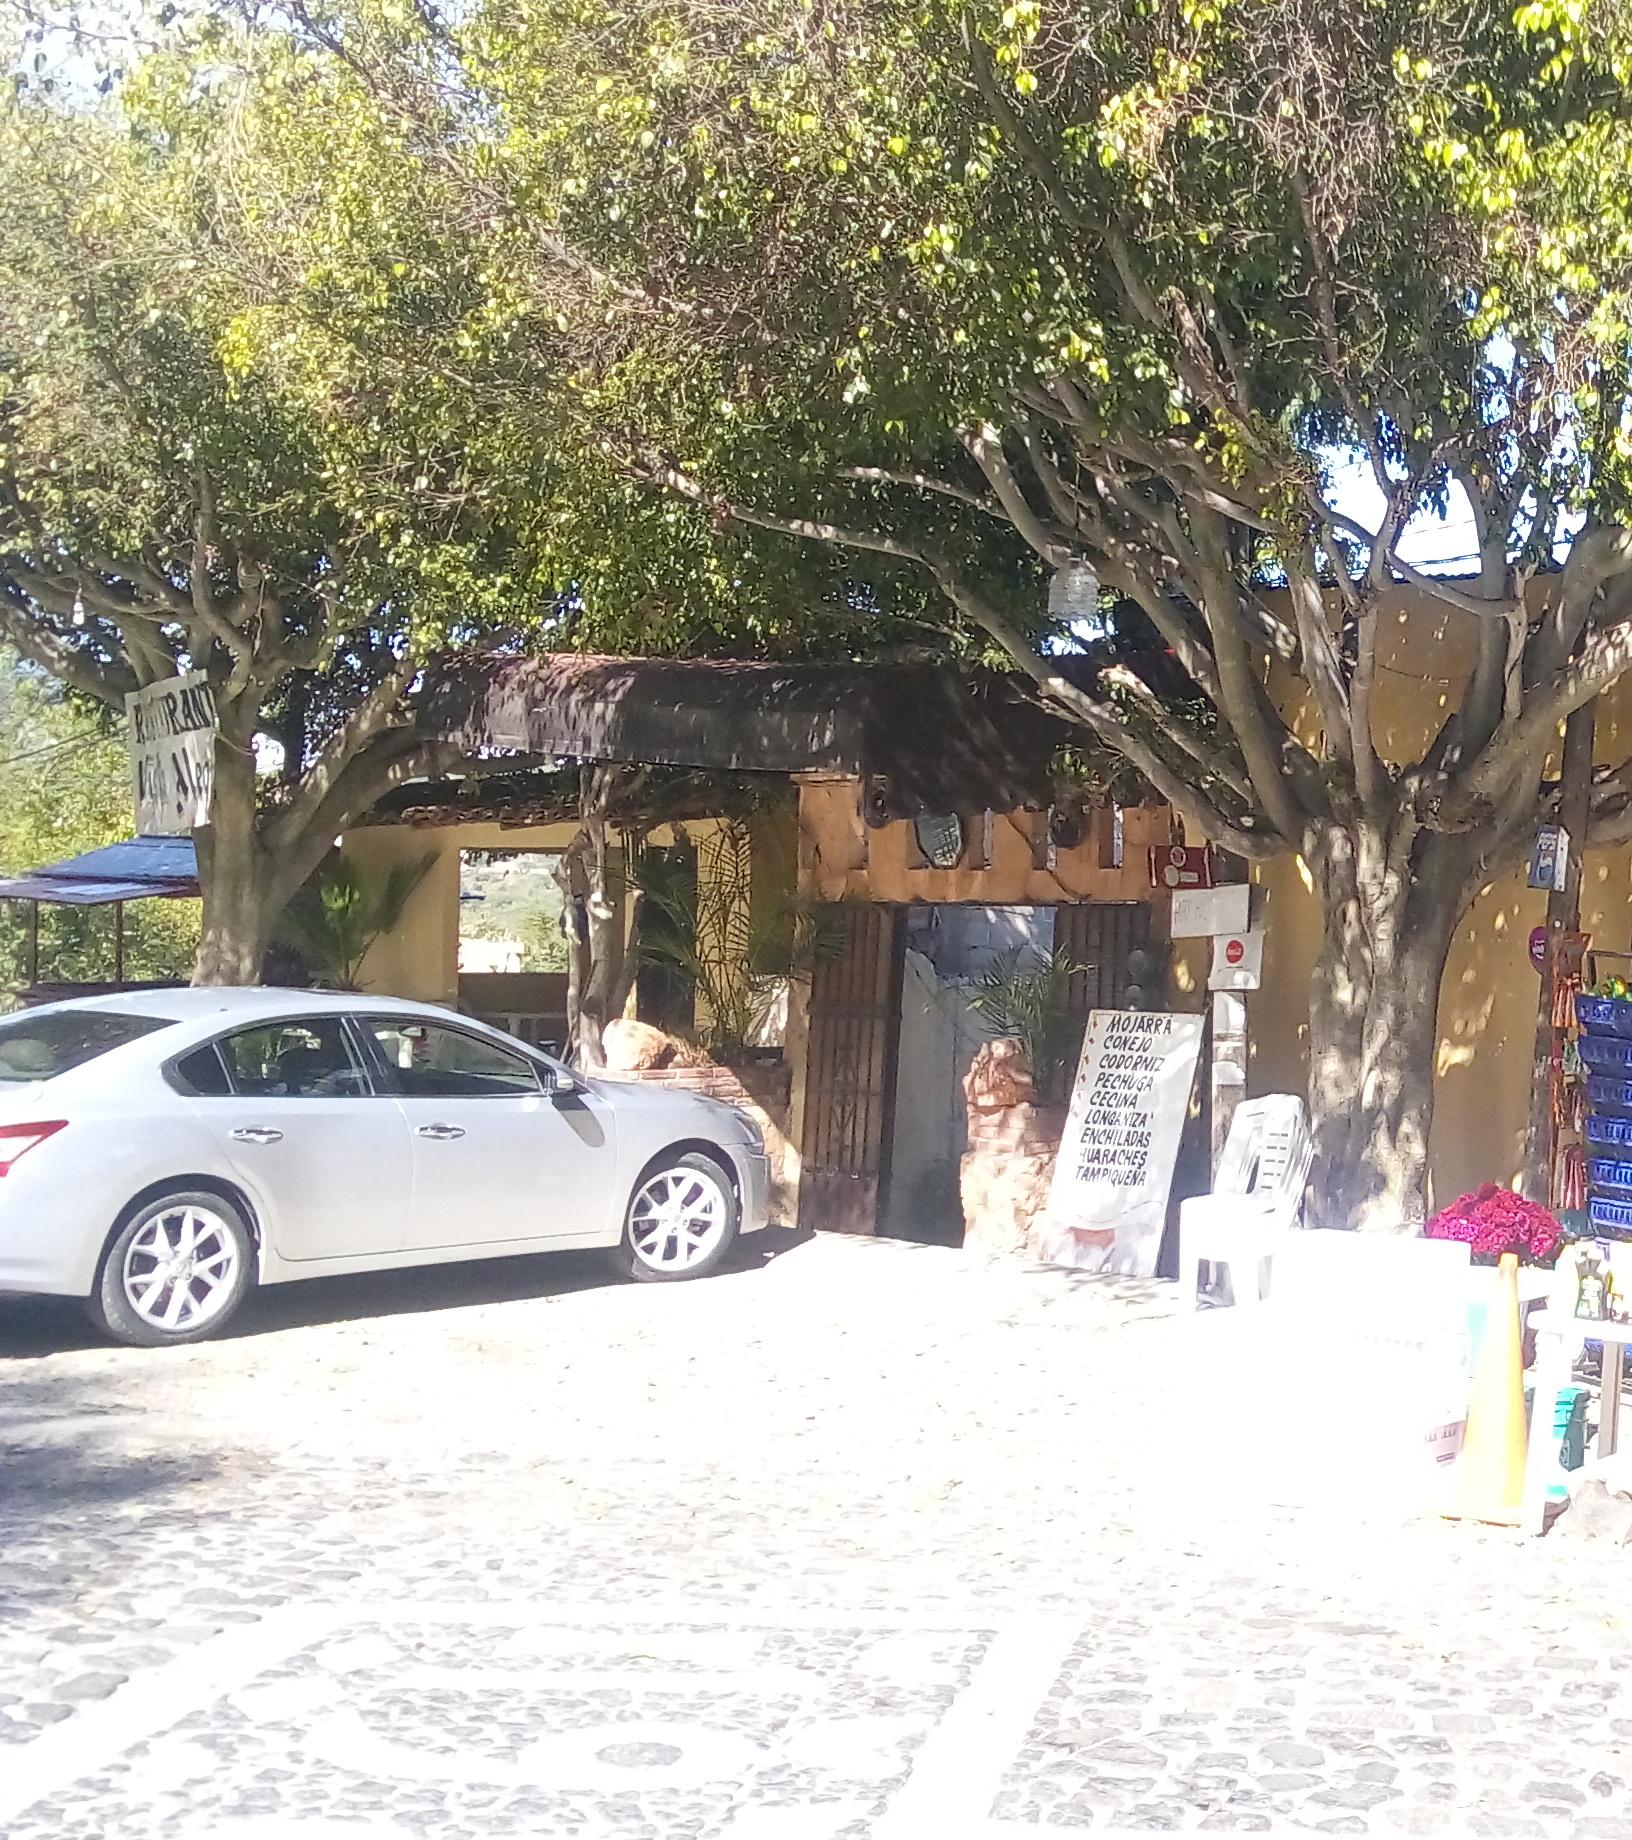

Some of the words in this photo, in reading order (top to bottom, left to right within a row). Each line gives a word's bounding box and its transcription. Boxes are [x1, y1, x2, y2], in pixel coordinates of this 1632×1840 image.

[1106, 1015, 1172, 1035] MOJARRA
[1103, 1034, 1153, 1053] CONEJO
[1099, 1053, 1166, 1072] CODORNIZ
[1094, 1072, 1154, 1093] PECHUGA
[1089, 1090, 1139, 1109] CECINA
[1084, 1108, 1148, 1128] LONGANIZA
[1080, 1127, 1152, 1149] ENCHILADAS
[1079, 1147, 1148, 1169] HUARACHES
